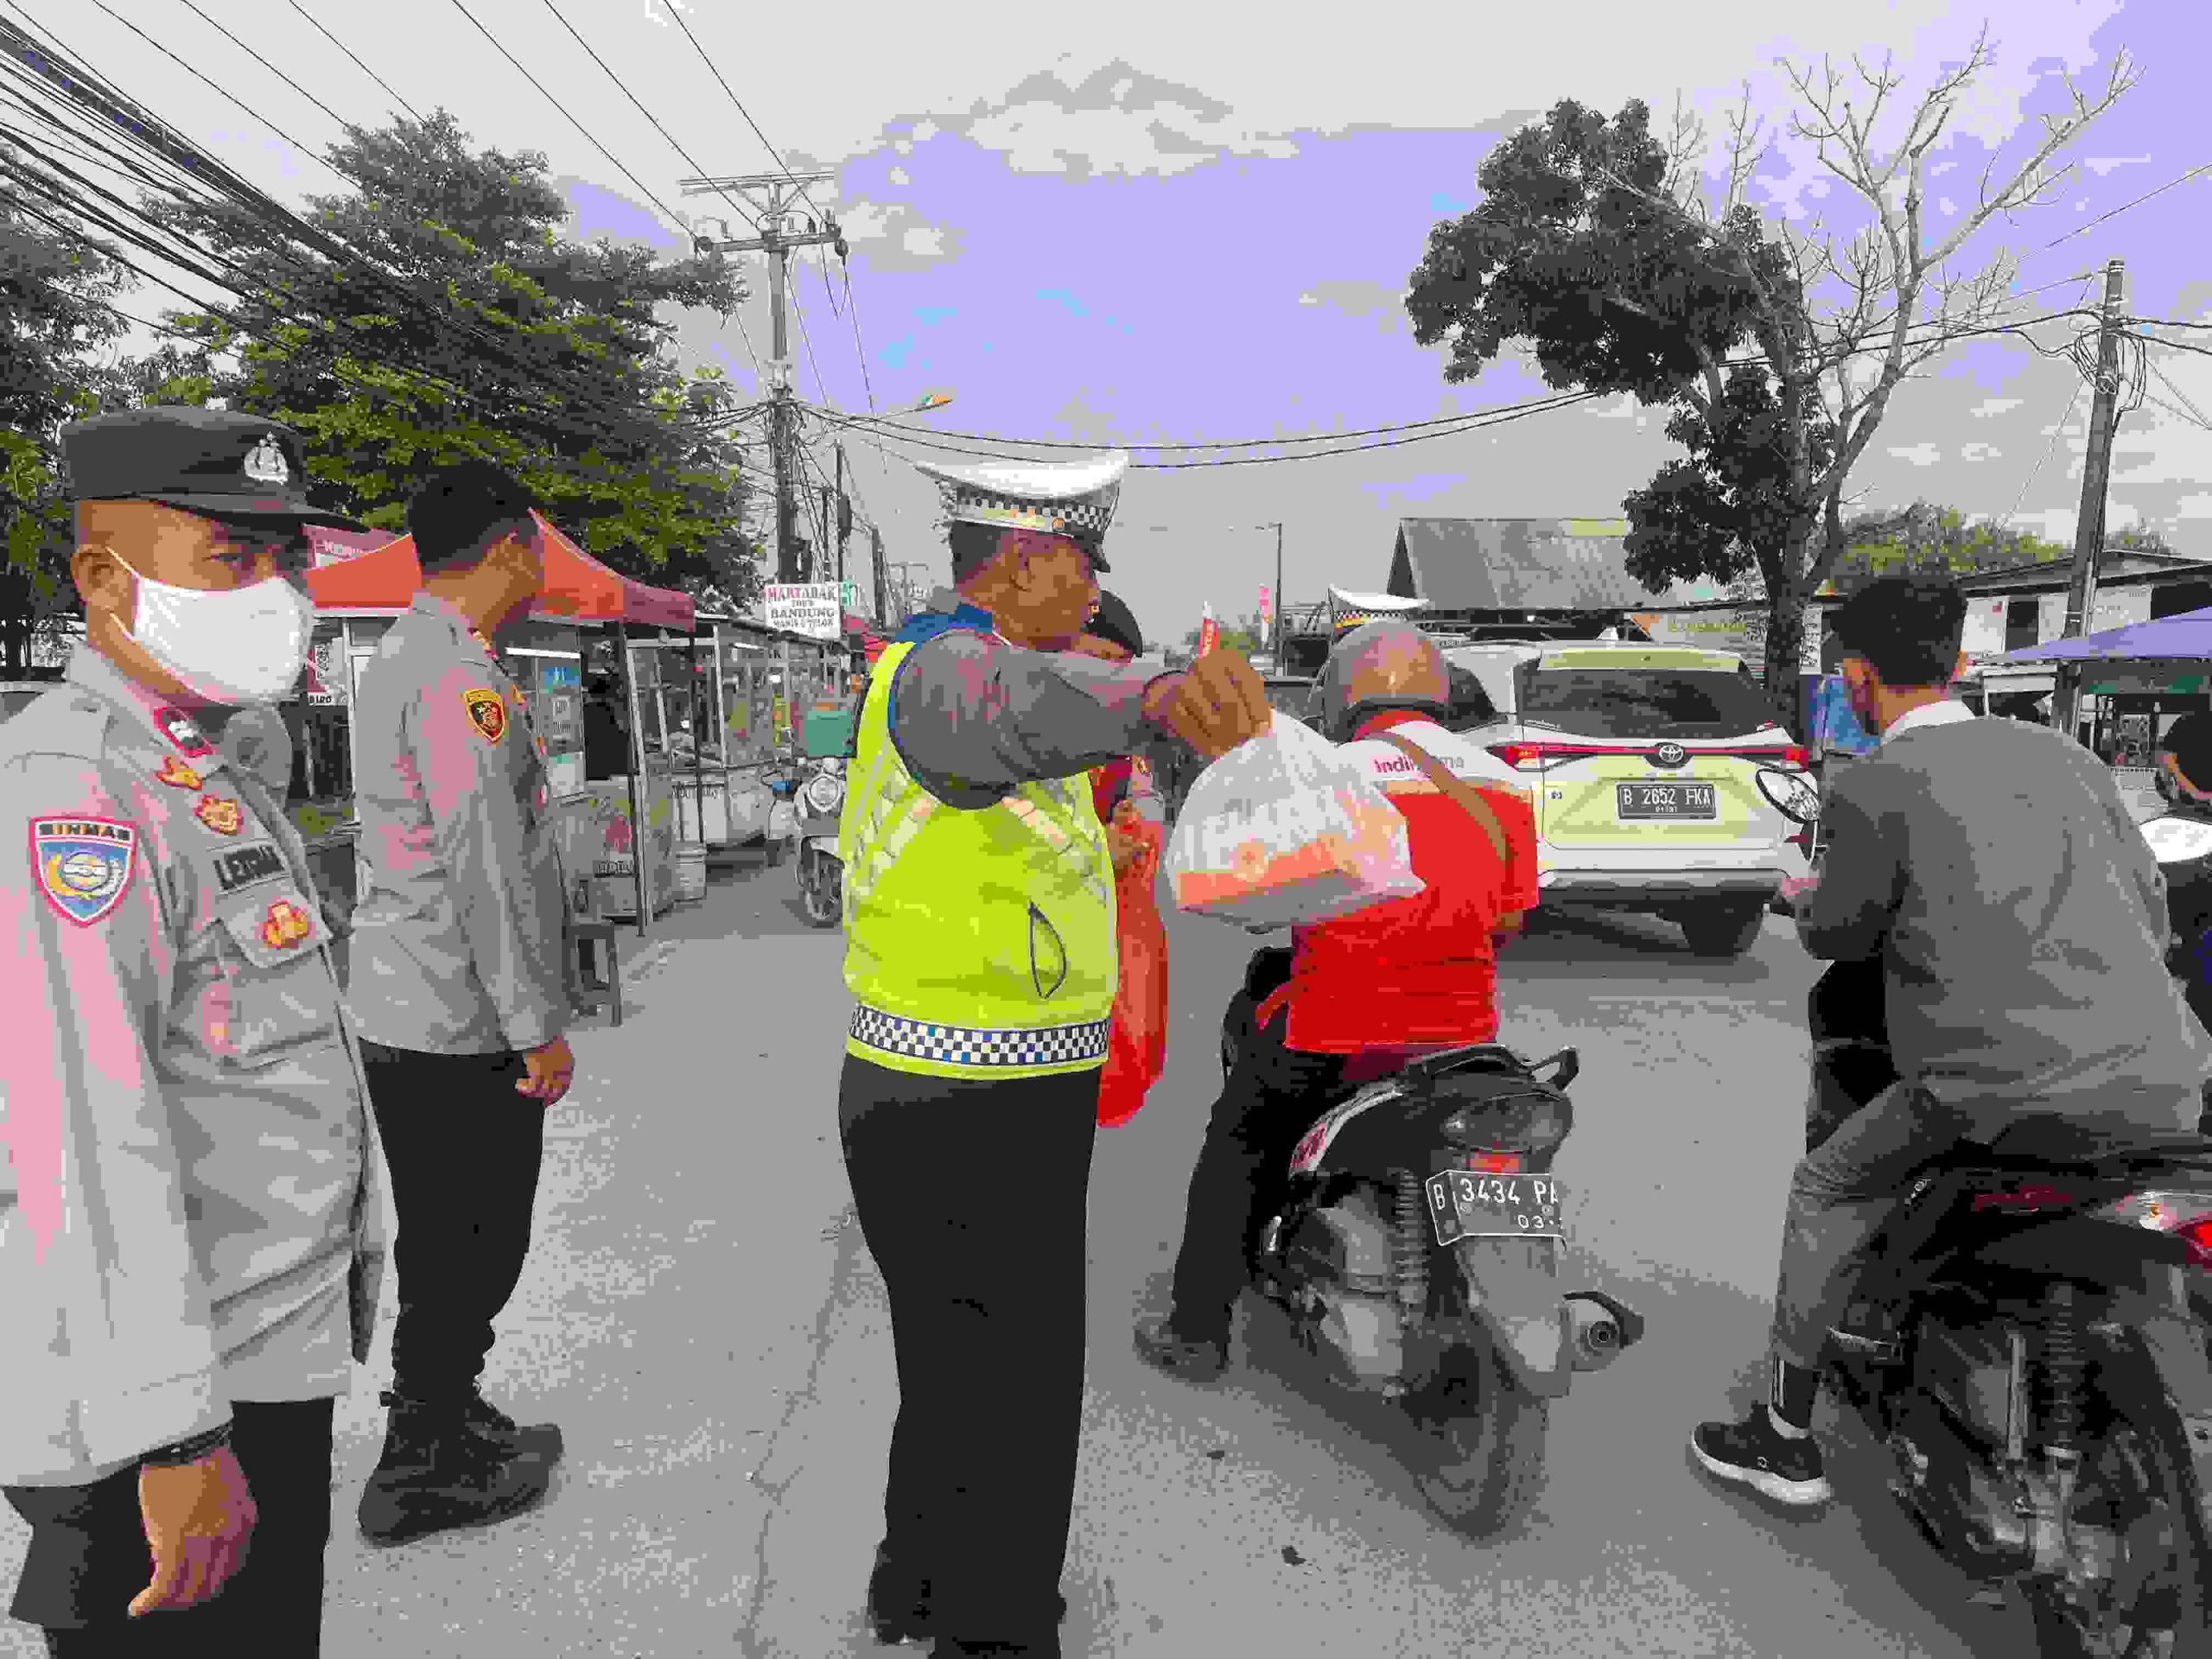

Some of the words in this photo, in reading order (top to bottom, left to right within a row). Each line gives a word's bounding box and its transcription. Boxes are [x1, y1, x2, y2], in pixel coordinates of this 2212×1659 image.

[767, 586, 836, 602] MARTABAK
[771, 607, 835, 619] BANDUNG
[1623, 787, 1633, 805] B
[1643, 787, 1677, 805] 2652
[1685, 788, 1712, 806] FKA
[1433, 1183, 1446, 1211] B
[1459, 1178, 1521, 1205] 3434
